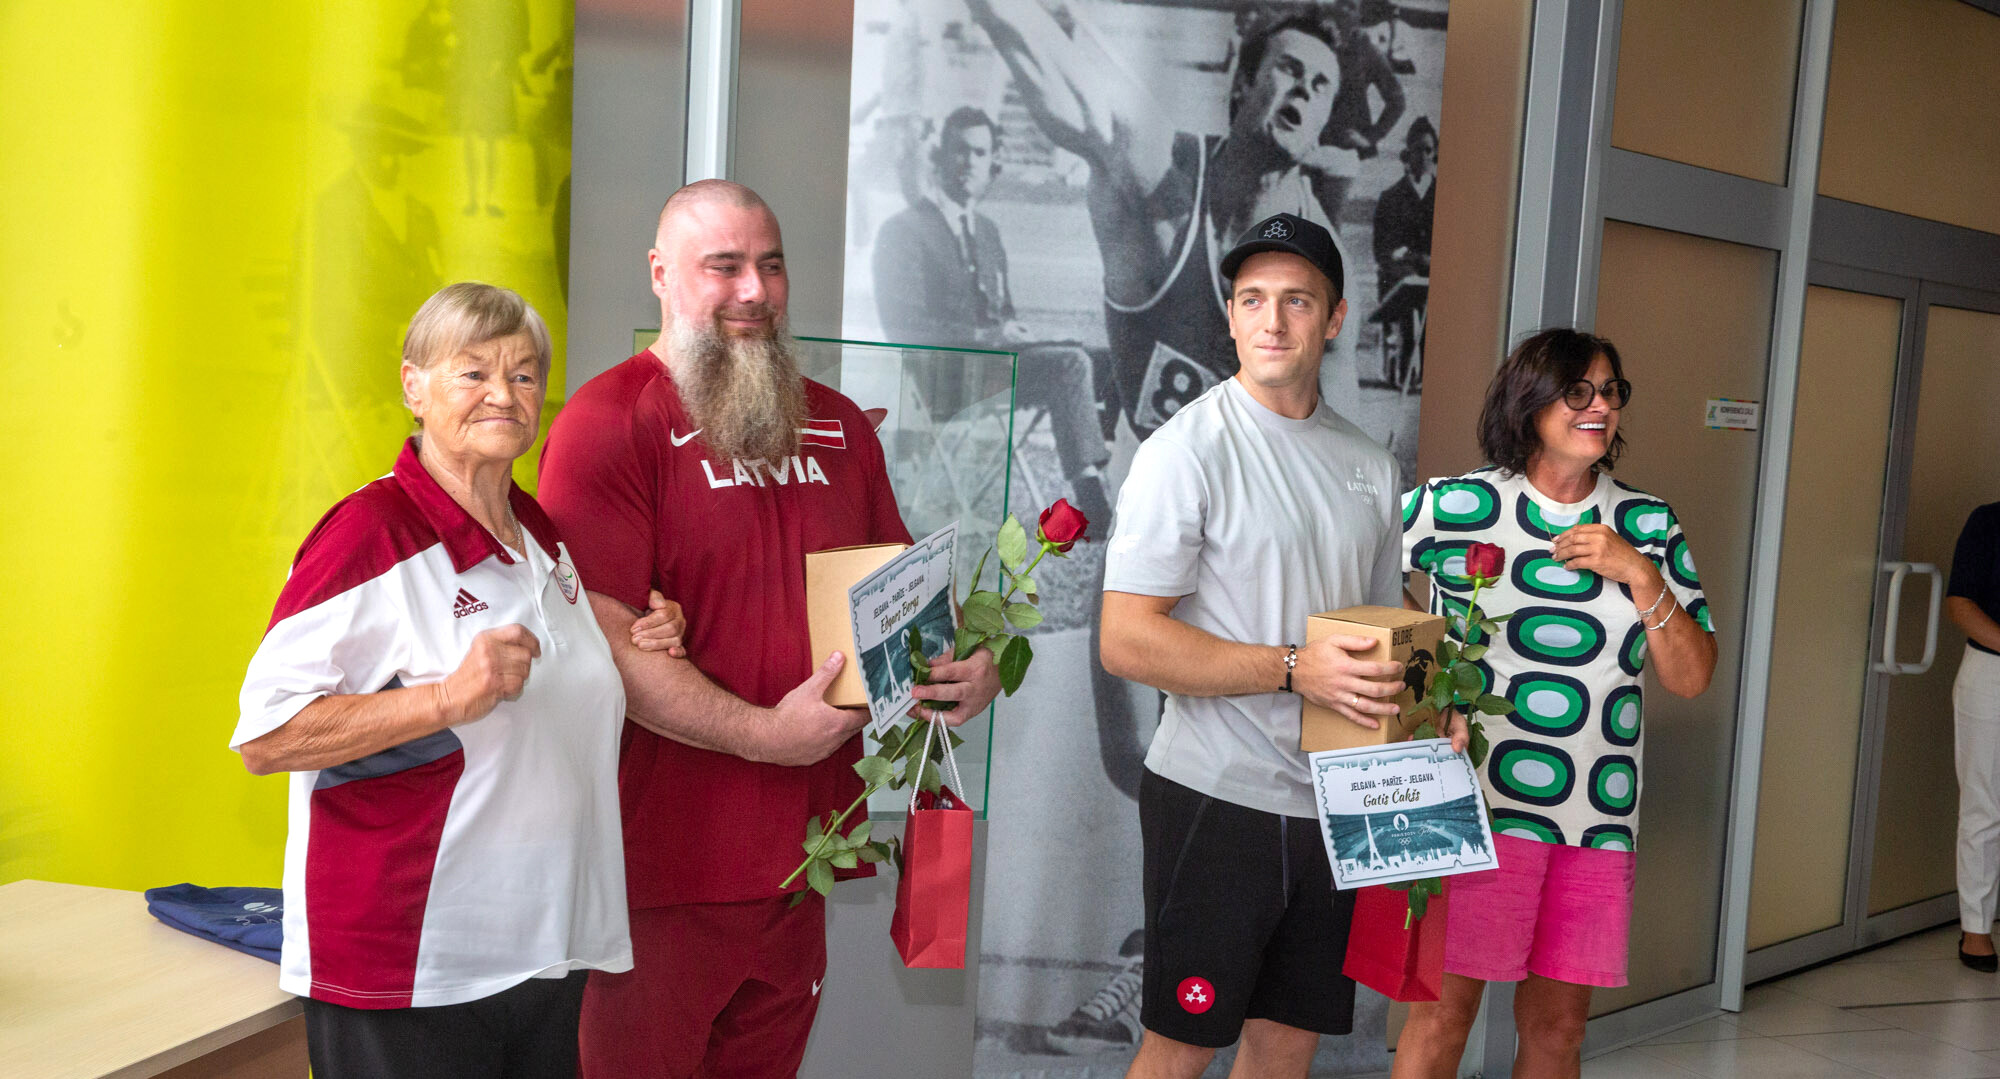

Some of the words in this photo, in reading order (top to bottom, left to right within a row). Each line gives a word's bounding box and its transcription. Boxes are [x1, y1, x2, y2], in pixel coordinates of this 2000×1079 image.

[1151, 358, 1203, 421] 8
[700, 455, 830, 489] LATVIA
[453, 601, 489, 618] adidas
[1392, 628, 1412, 646] GLOBE
[1351, 780, 1376, 791] JELGAVA
[1382, 776, 1403, 787] PARĪZE
[1409, 773, 1434, 784] JELGAVA
[1363, 793, 1389, 807] Gatis
[1392, 788, 1420, 804] Čakšs
